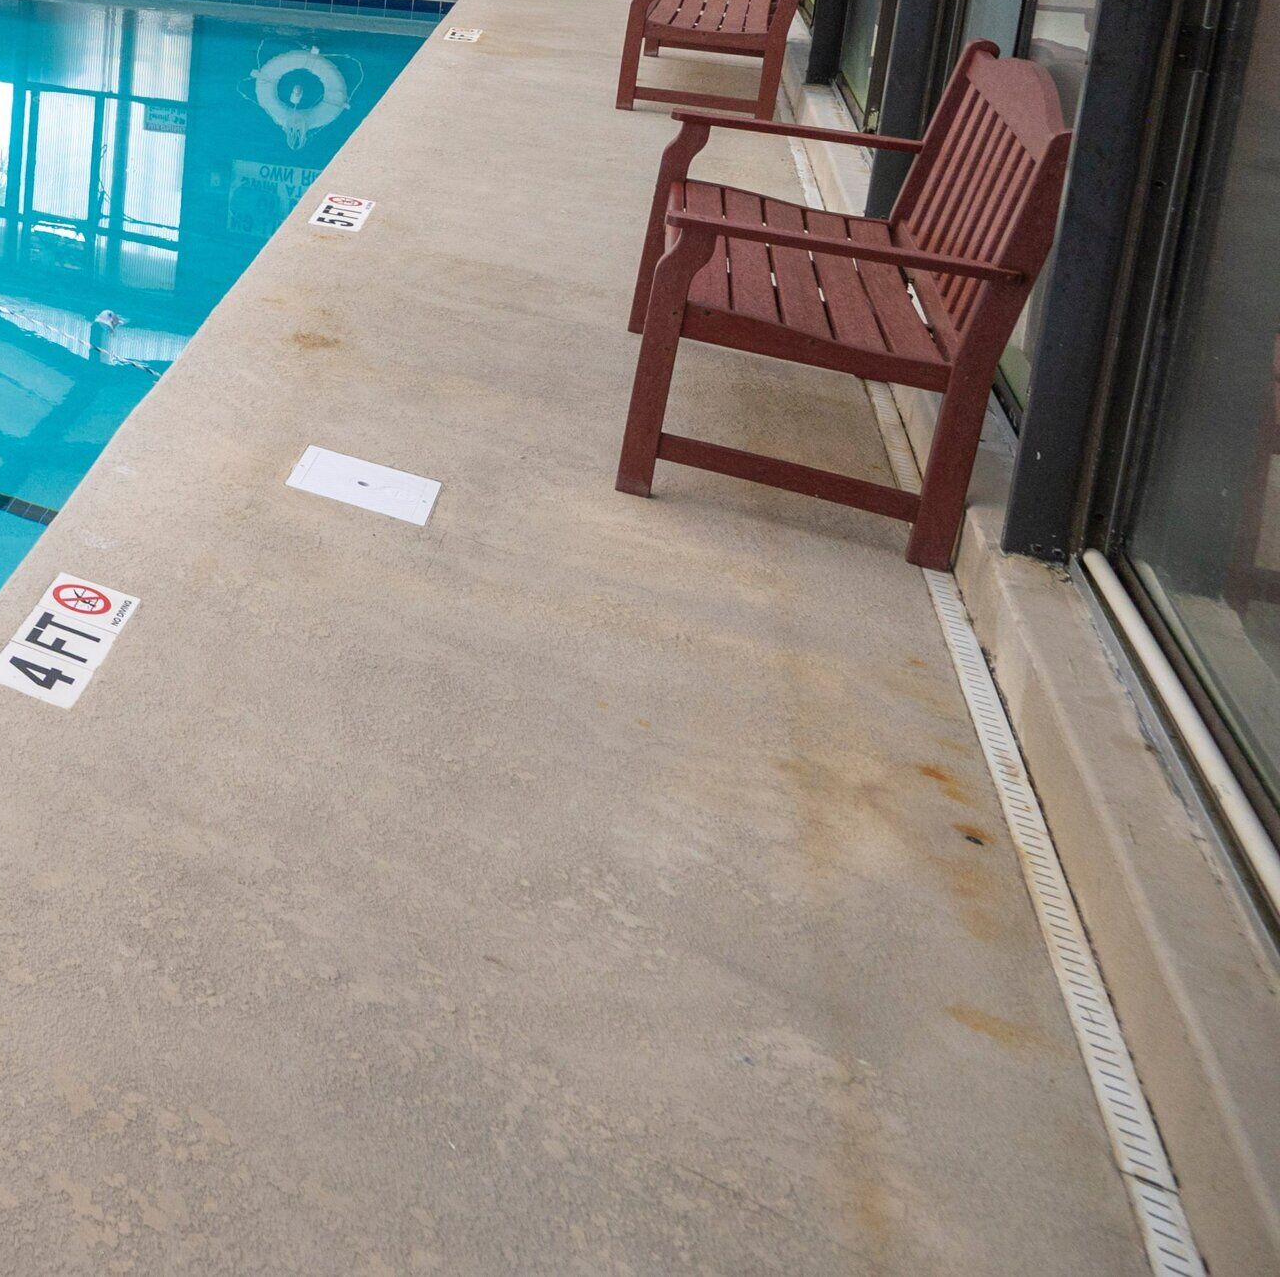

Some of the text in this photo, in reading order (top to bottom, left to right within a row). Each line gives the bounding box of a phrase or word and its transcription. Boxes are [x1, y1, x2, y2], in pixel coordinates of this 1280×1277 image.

[316, 205, 362, 227] 5 FT
[111, 599, 133, 627] NO DIVING
[9, 611, 101, 690] 4 FT
